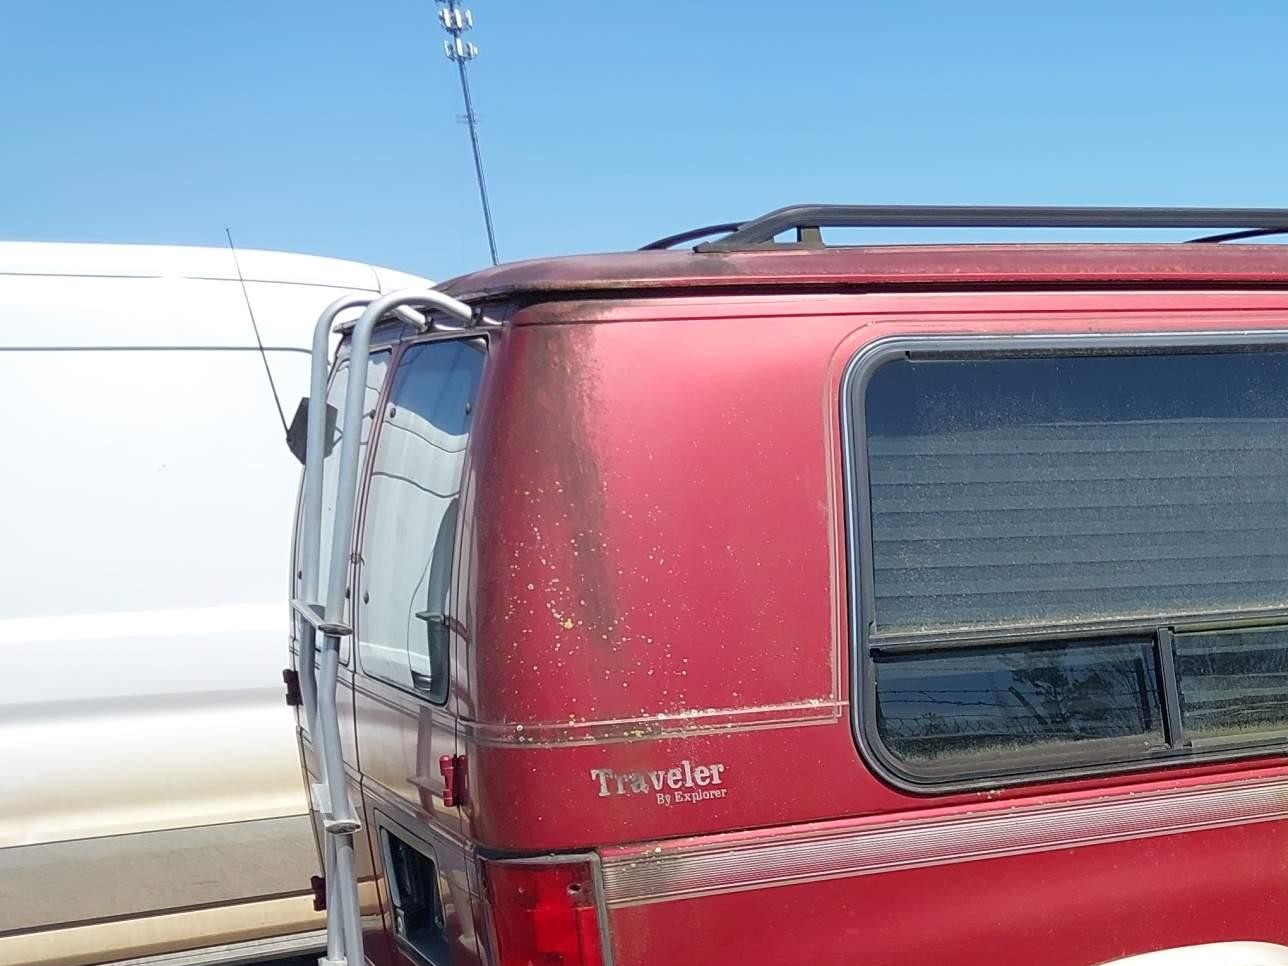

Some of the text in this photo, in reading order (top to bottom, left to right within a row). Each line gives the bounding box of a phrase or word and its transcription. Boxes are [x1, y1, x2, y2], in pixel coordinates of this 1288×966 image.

[590, 760, 725, 797] Traveler
[656, 788, 727, 806] By Explorer
